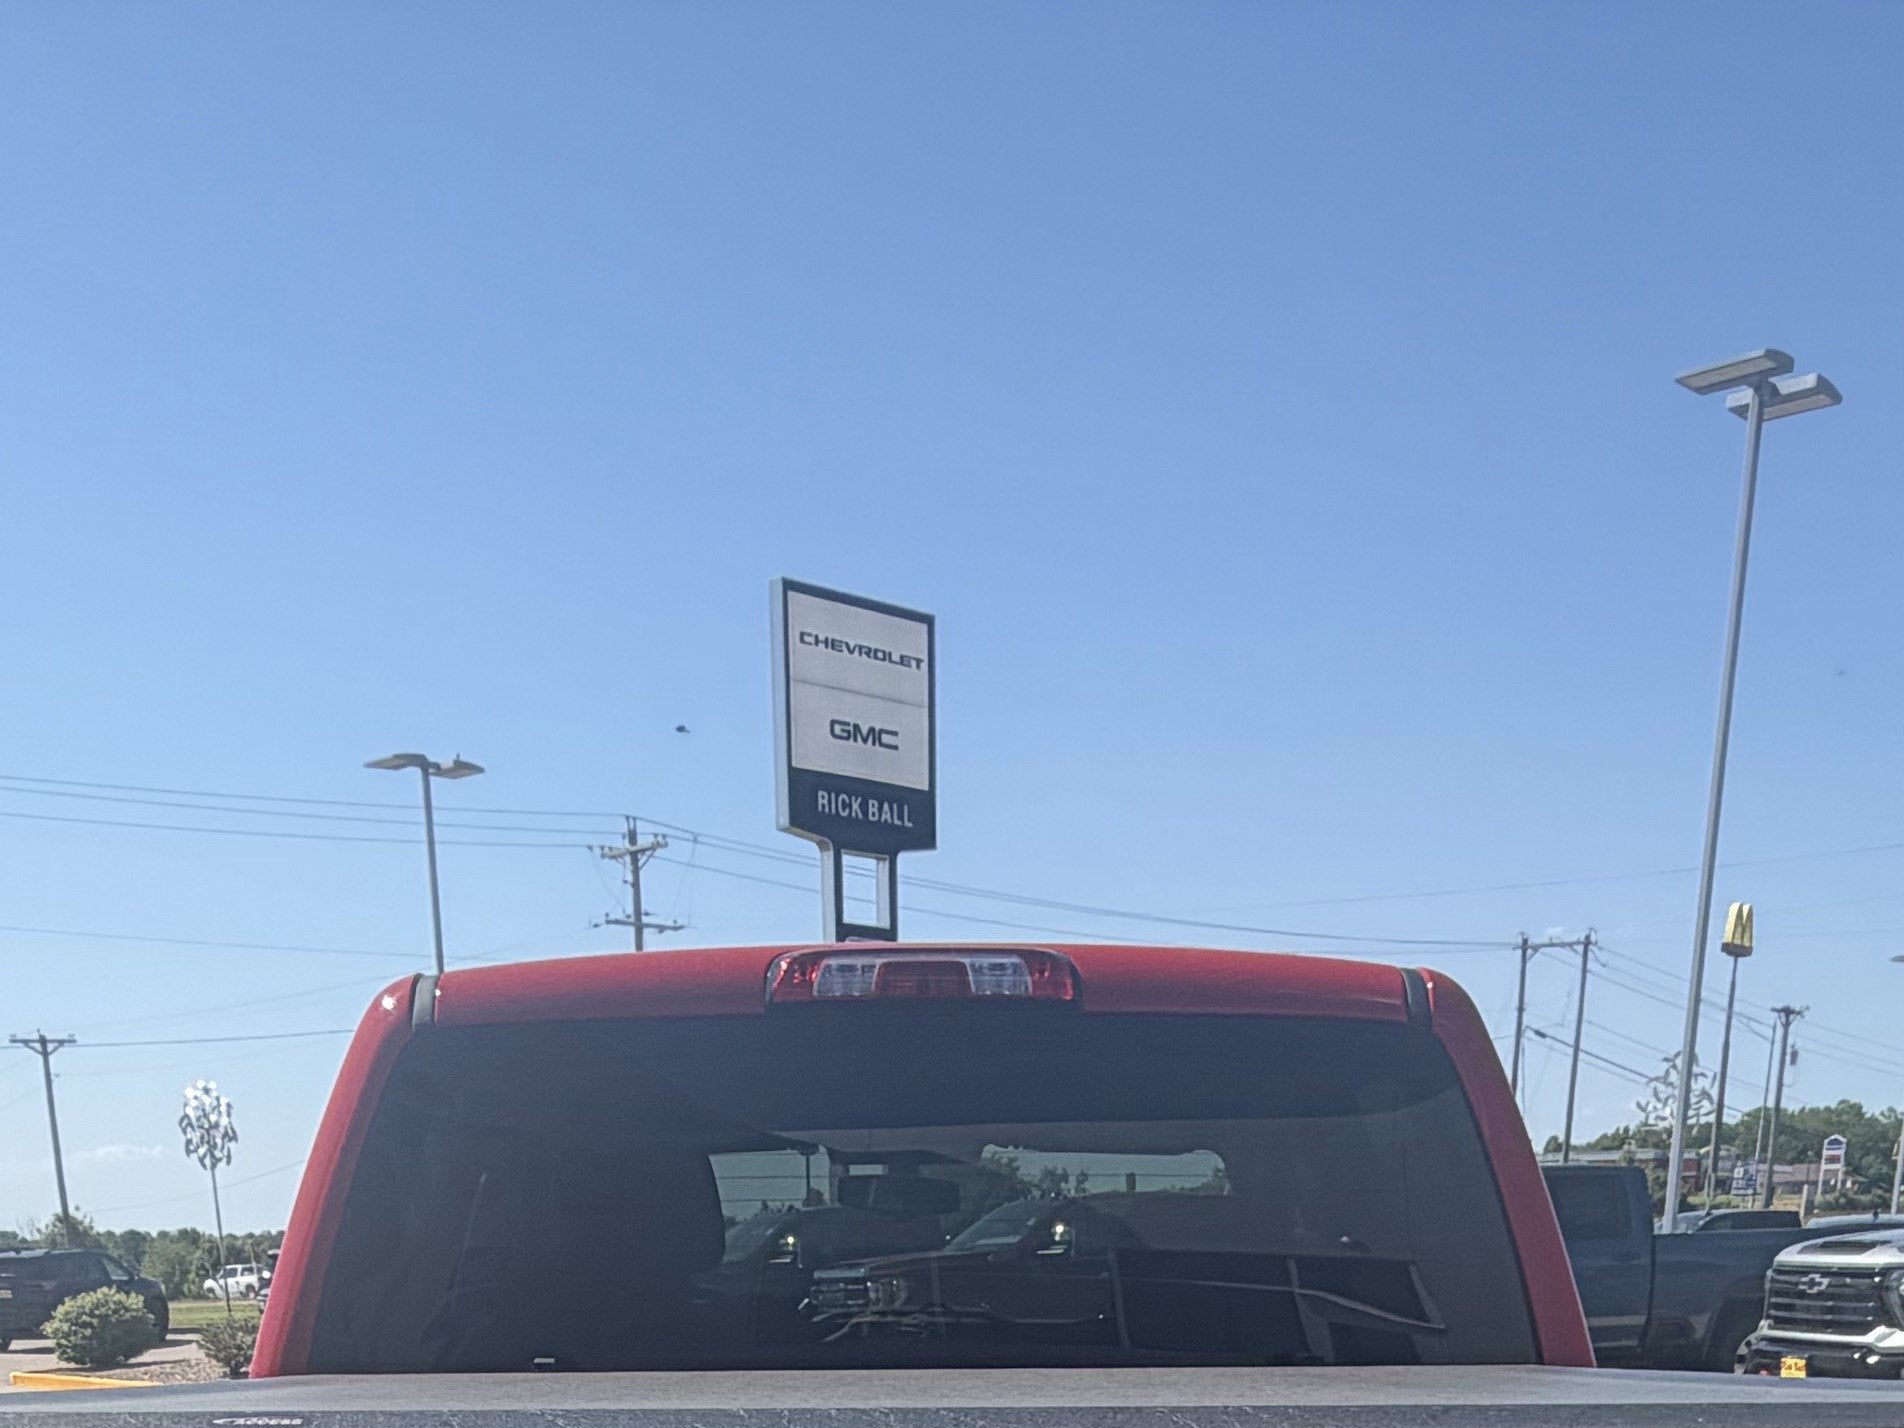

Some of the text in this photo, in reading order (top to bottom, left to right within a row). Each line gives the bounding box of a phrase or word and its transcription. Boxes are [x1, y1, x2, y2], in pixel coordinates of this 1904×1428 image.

[799, 630, 925, 671] CHEVROLET
[829, 718, 900, 751] GMC
[817, 789, 914, 828] RICK BALL
